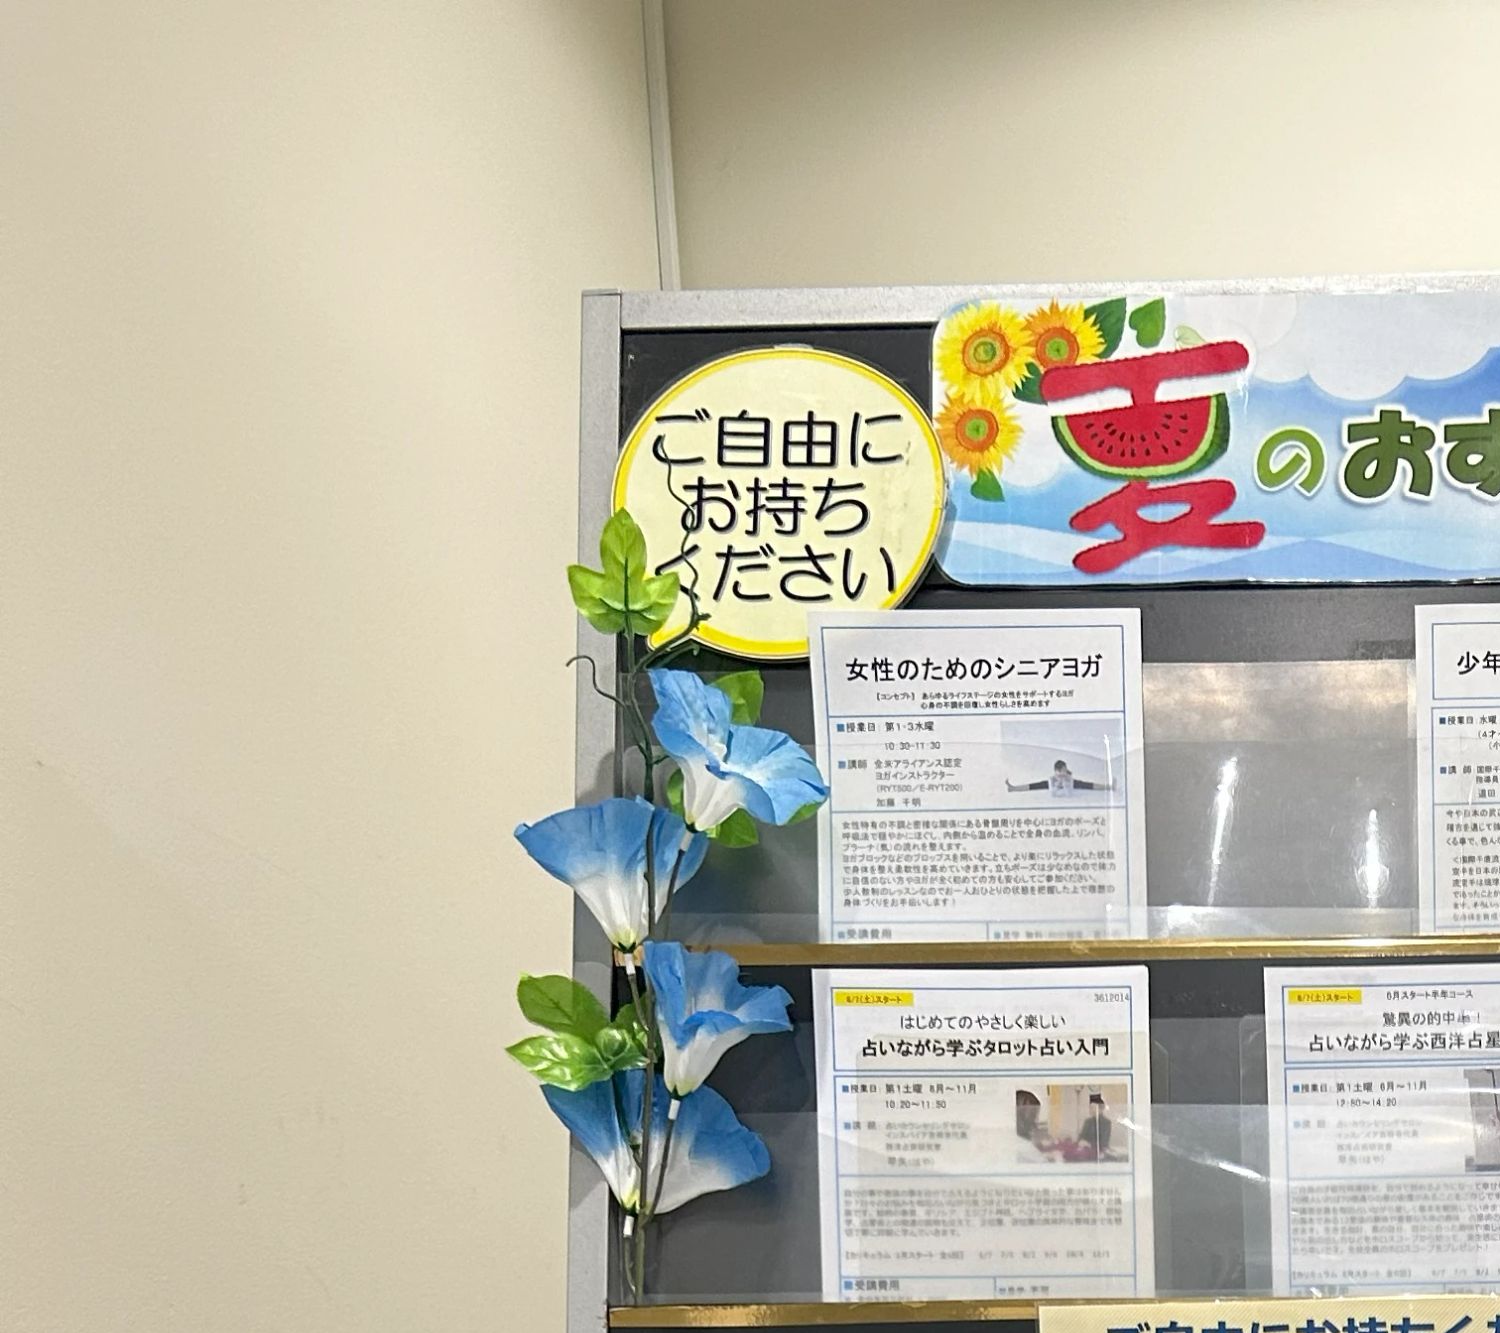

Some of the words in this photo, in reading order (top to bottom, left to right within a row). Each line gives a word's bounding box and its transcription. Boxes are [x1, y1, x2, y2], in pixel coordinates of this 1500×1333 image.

[653, 408, 905, 469] ご自由に
[682, 477, 872, 536] お持ち
[655, 543, 898, 602] ください
[846, 655, 1103, 682] 女性のためのシニアヨガ
[900, 1014, 1067, 1031] はじめてのやさしく楽しい
[862, 1037, 1110, 1058] 占いながら学ぶタロット占い入門
